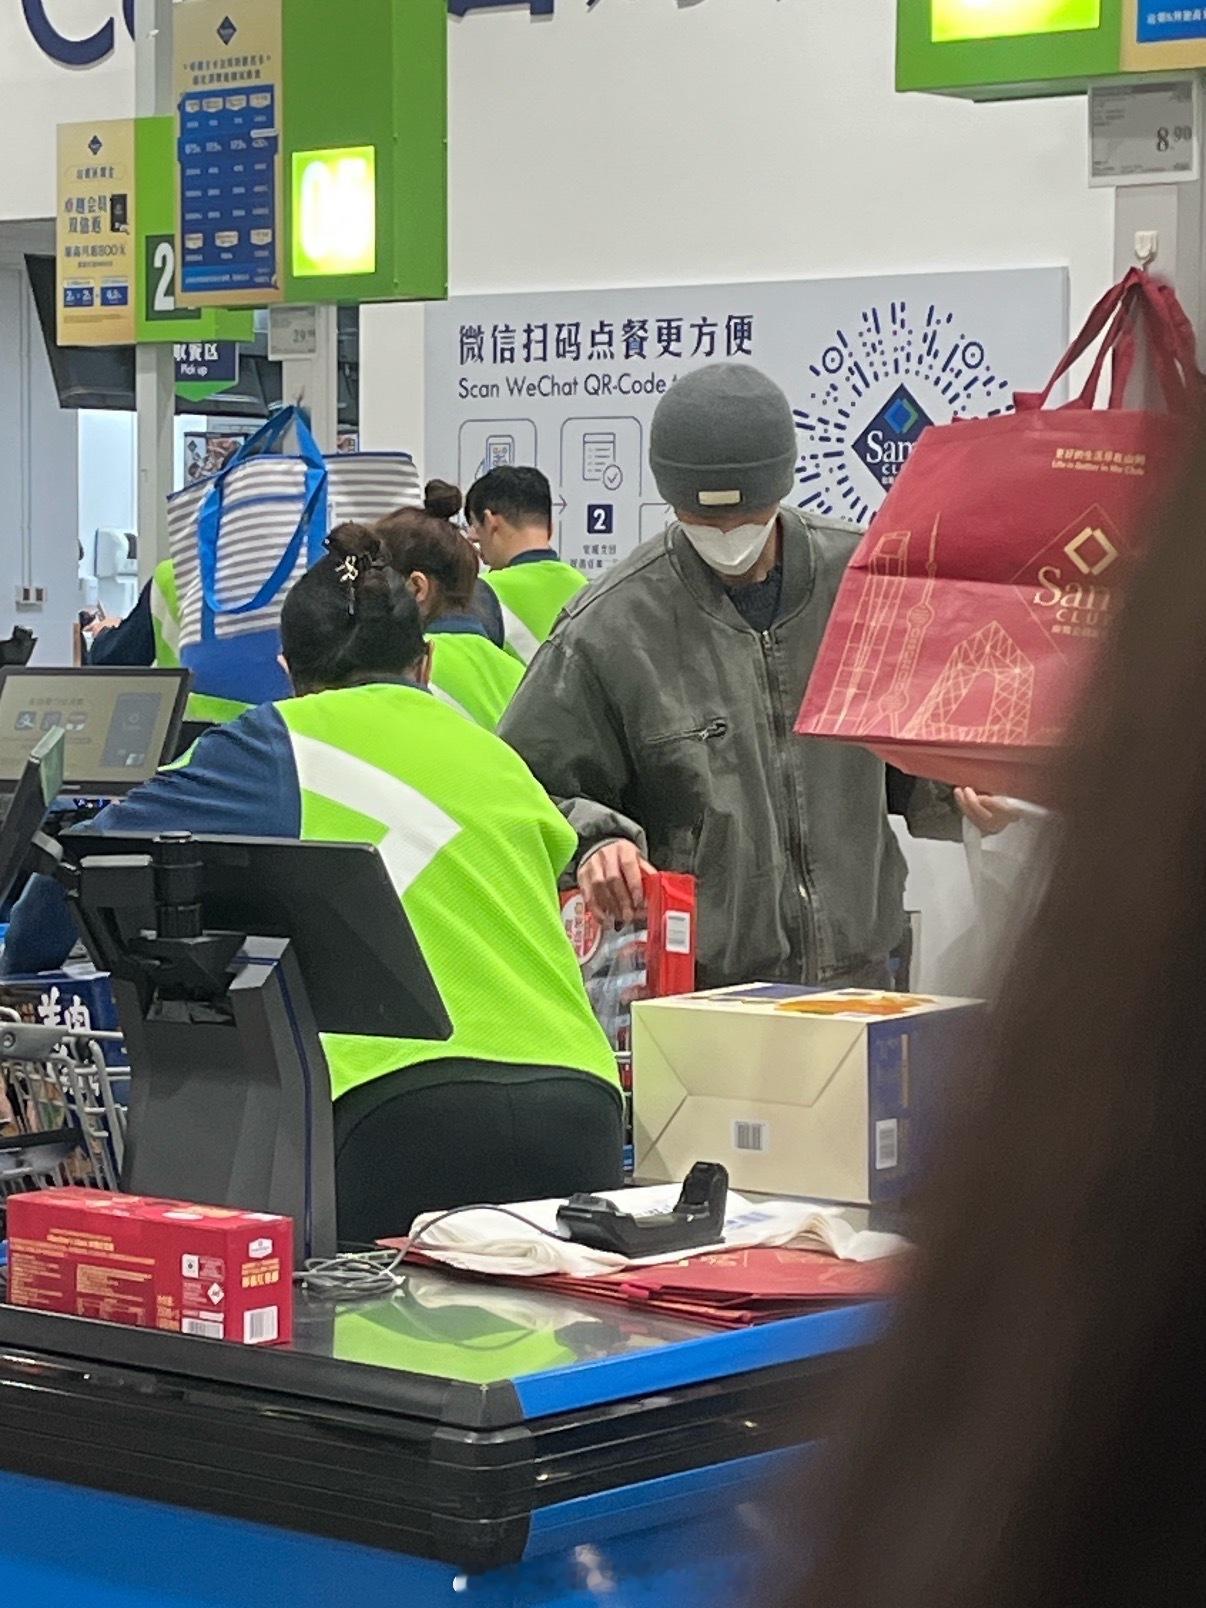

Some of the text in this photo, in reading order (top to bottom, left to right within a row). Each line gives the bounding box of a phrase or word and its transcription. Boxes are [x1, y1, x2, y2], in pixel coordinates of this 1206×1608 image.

[458, 314, 754, 366] 微信扫码点餐更方便
[458, 377, 500, 400] Scan
[505, 374, 578, 397] WeChat
[584, 370, 667, 396] QR-Code
[593, 508, 607, 530] 2
